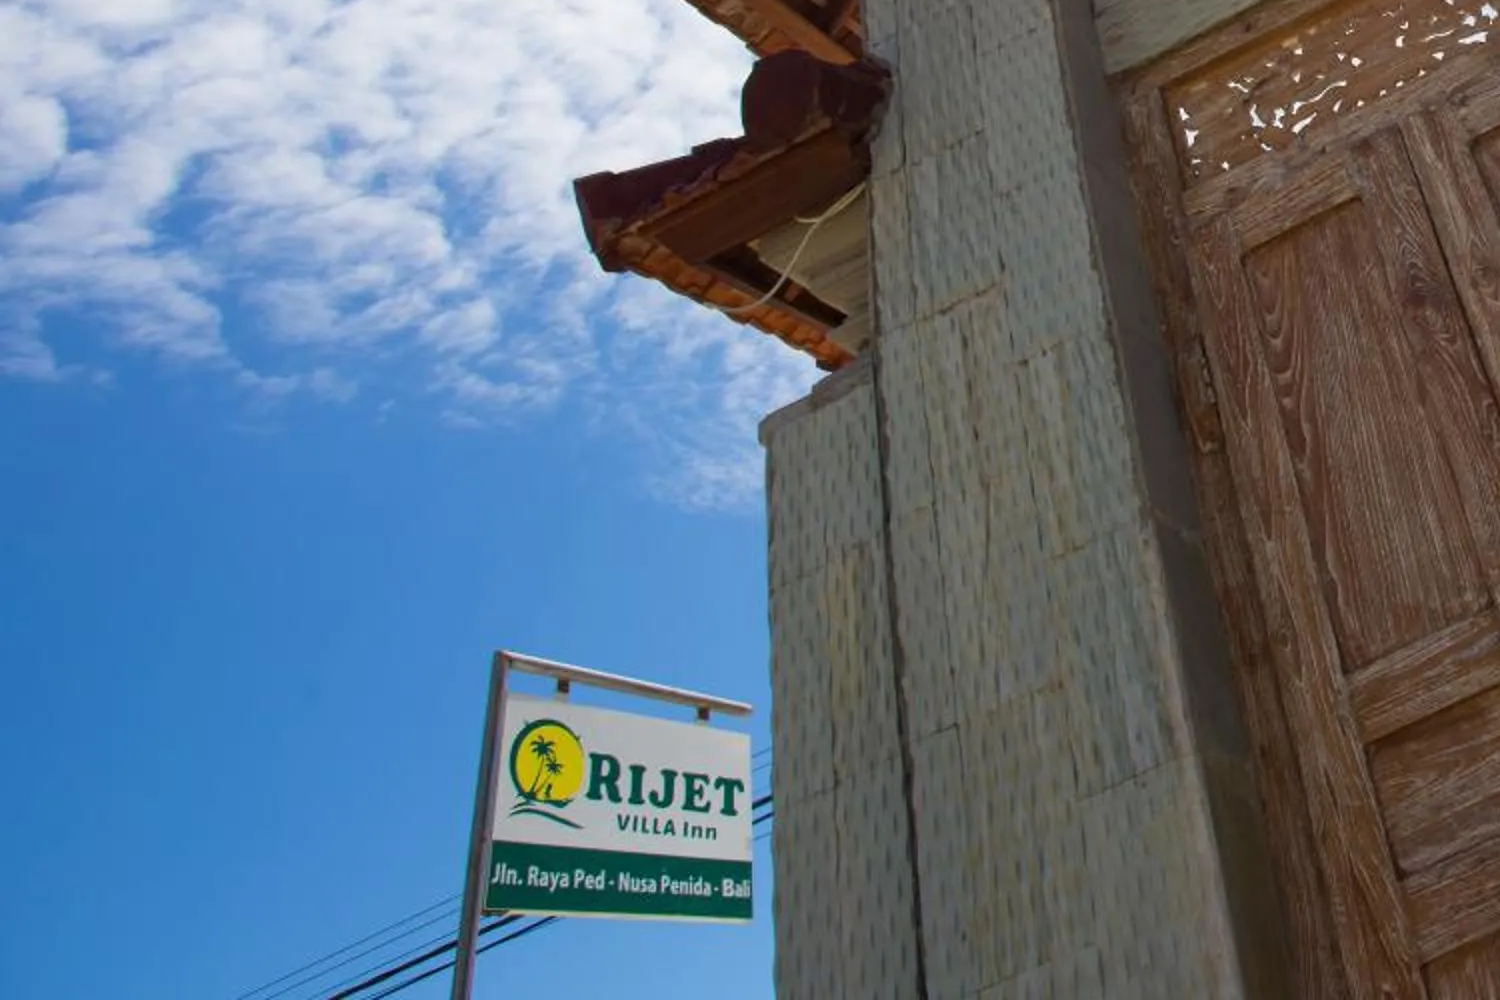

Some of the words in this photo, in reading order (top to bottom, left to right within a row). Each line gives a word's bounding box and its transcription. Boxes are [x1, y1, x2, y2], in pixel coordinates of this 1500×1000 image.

[617, 814, 676, 837] VILLA
[683, 822, 717, 840] Inn
[491, 863, 523, 886] Jln.
[527, 865, 569, 892] Raya
[574, 868, 606, 890] Ped
[618, 872, 657, 893] Nusa
[661, 874, 712, 897] Penida
[722, 878, 751, 898] Bali
